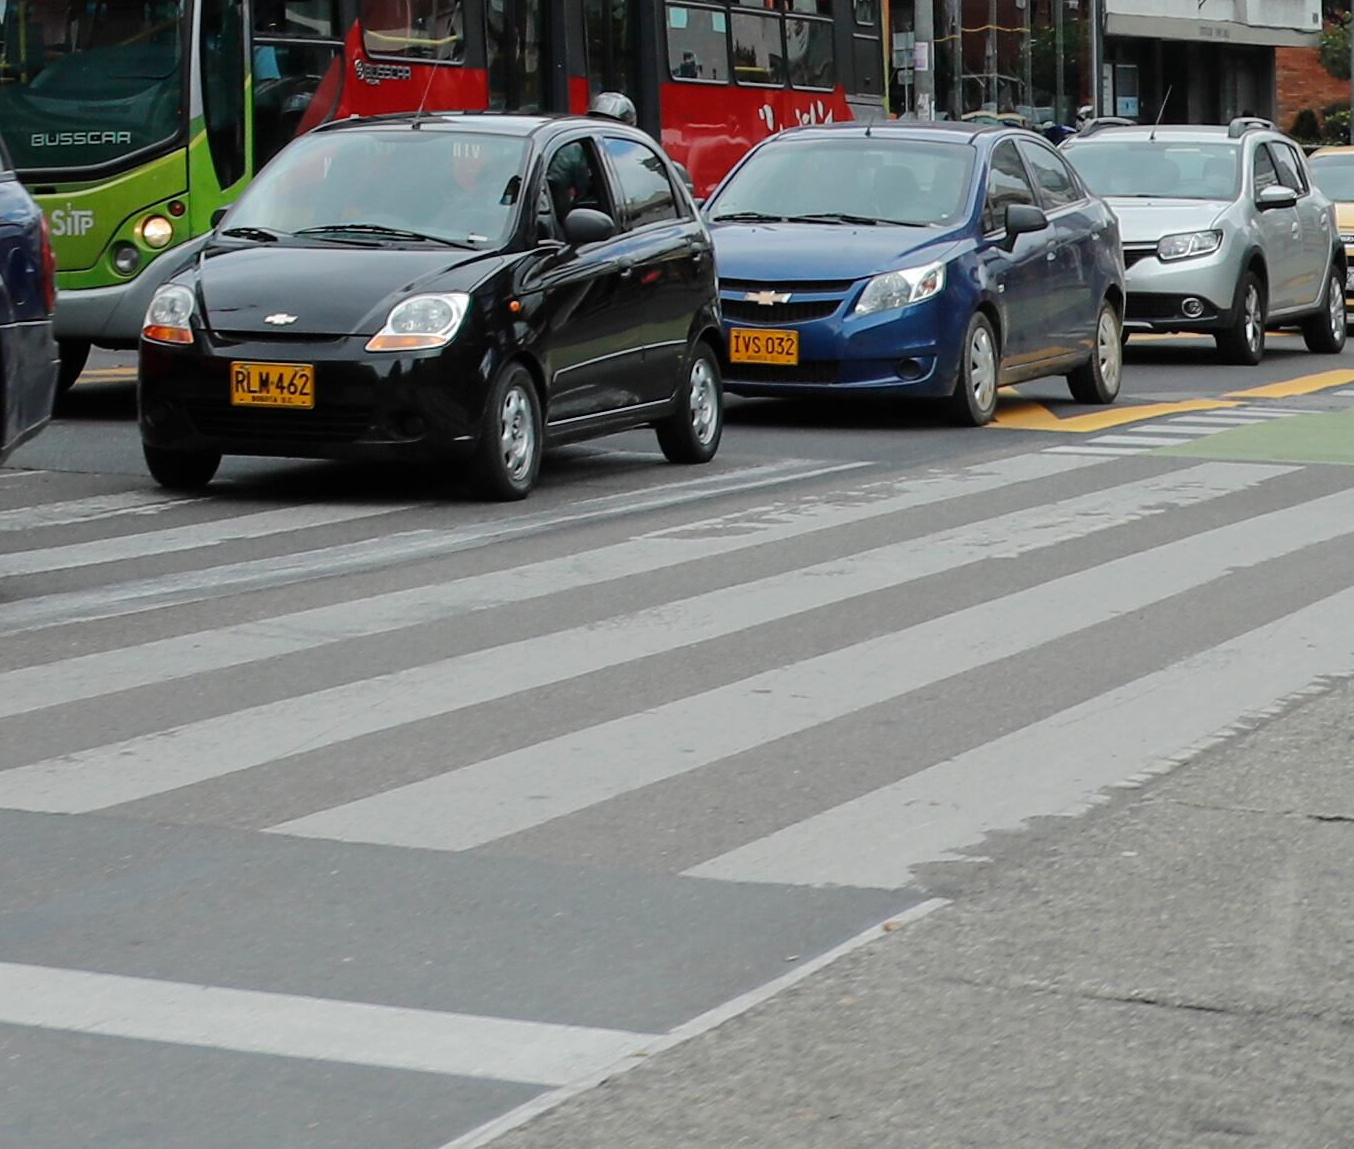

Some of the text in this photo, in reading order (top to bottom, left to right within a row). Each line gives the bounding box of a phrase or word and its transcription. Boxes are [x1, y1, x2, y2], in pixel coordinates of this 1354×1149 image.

[30, 131, 132, 147] BUSSCAR
[734, 335, 795, 356] IVS 032
